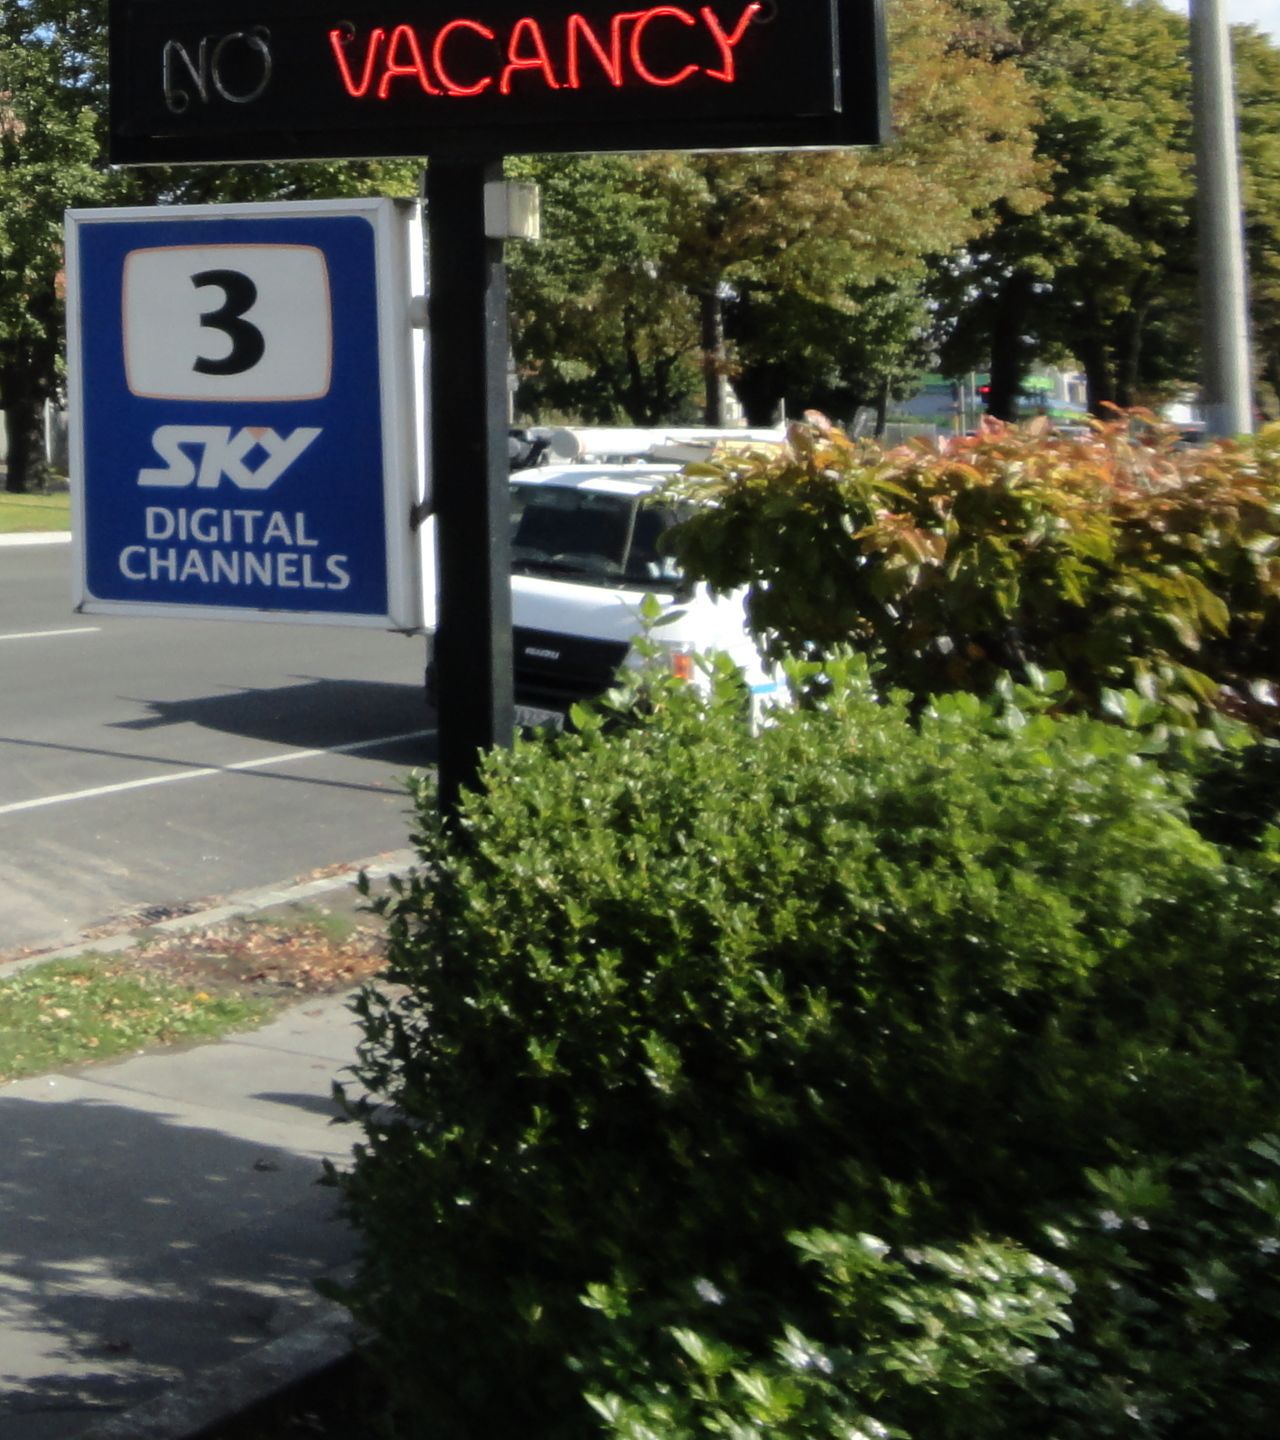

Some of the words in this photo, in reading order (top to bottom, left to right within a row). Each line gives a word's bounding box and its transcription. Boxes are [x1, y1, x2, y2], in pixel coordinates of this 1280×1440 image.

[163, 25, 273, 109] NO
[329, 2, 764, 99] VACANCY
[189, 268, 266, 376] 3
[136, 424, 324, 491] SKY
[145, 506, 319, 547] DIGITAL
[118, 545, 352, 591] CHANNELS
